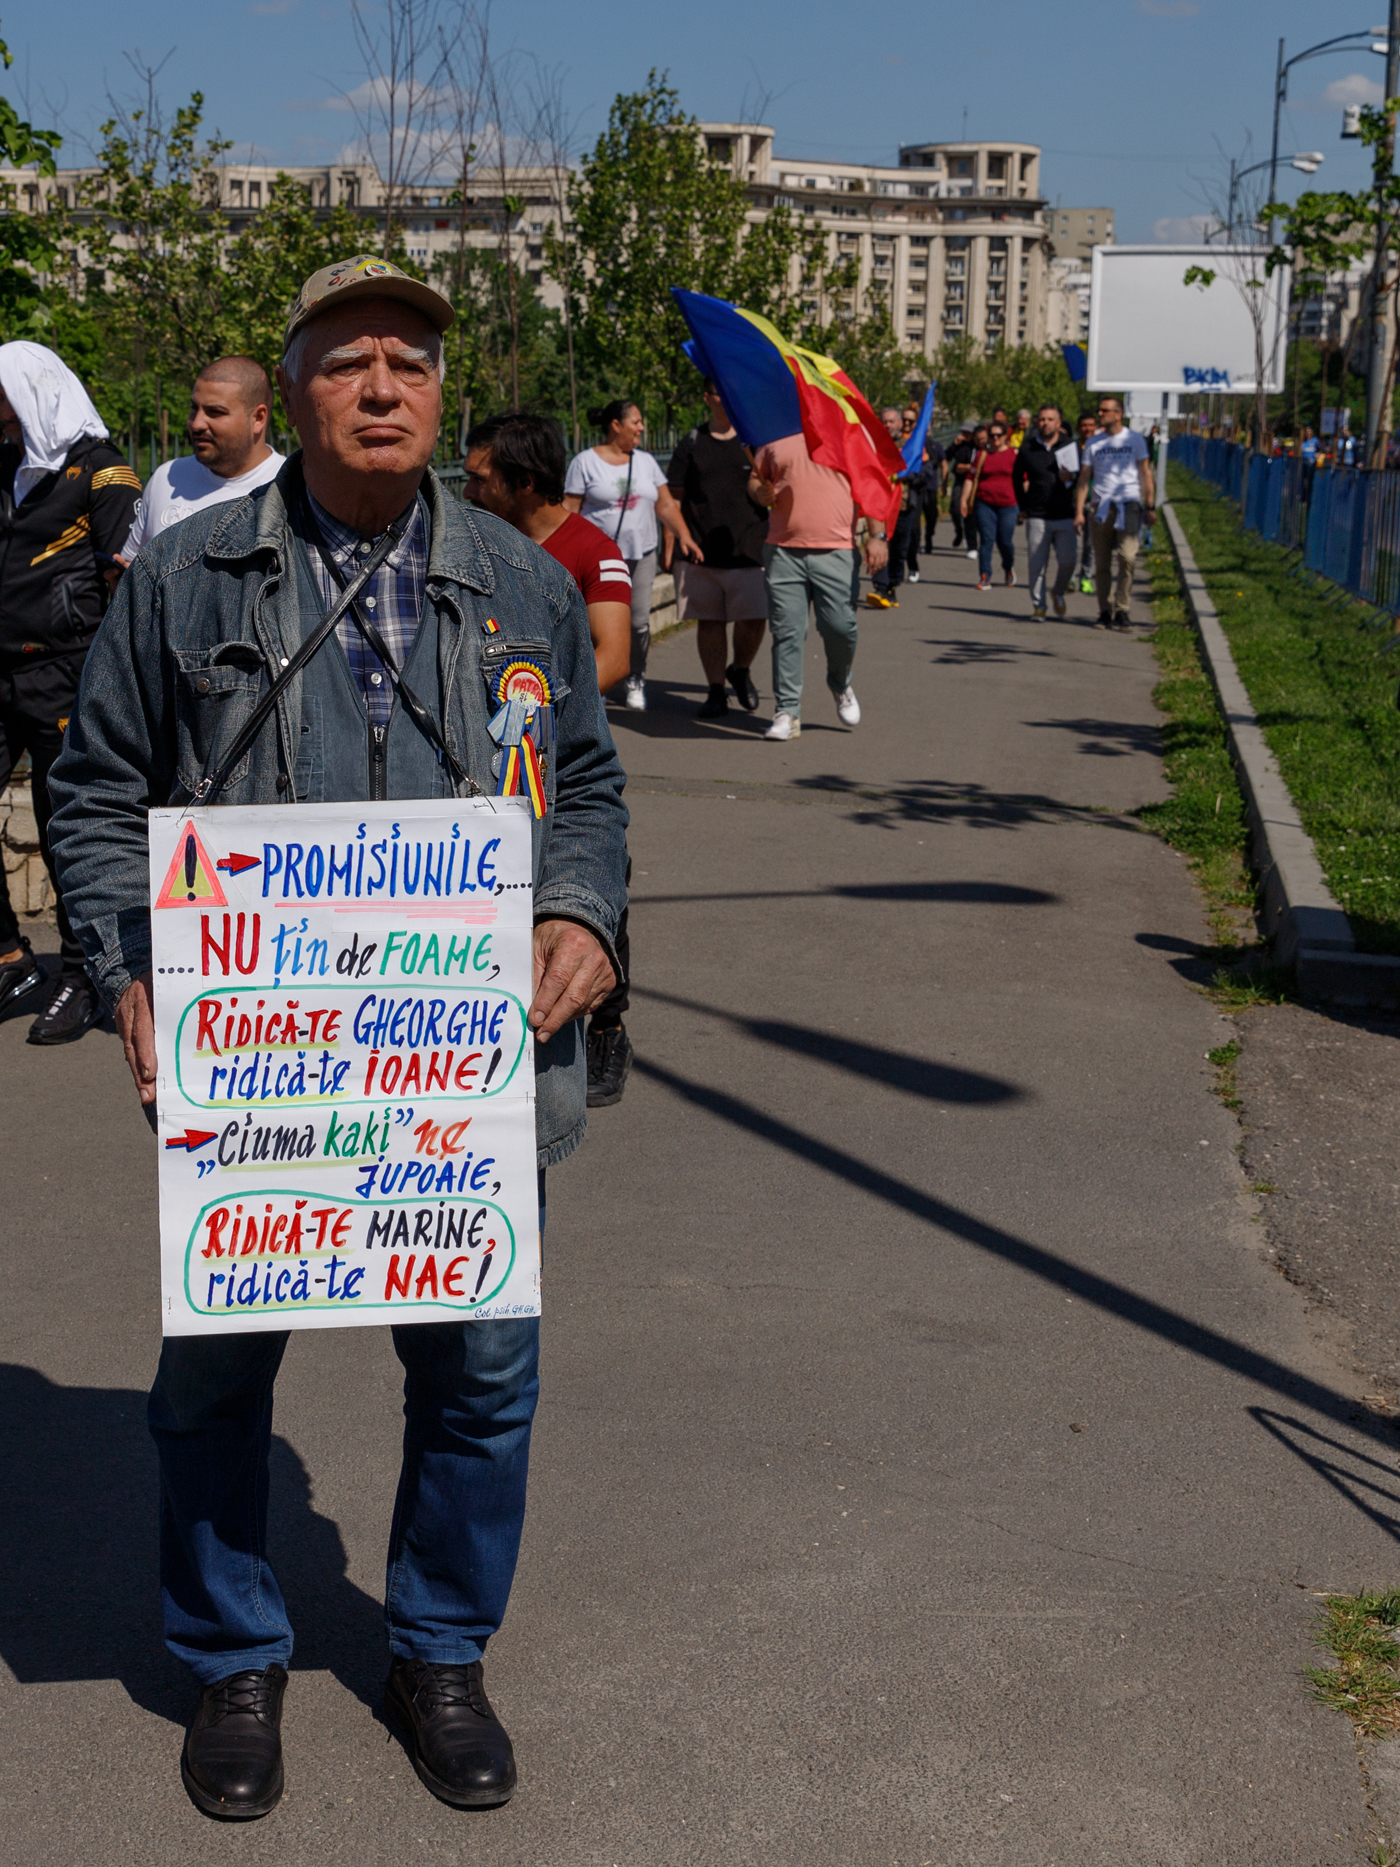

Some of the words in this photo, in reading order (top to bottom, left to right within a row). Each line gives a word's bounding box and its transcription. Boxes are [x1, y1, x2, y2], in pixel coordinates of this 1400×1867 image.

[335, 932, 378, 979] de
[378, 930, 501, 982] FOAME,
[353, 994, 509, 1050] GHEORGHE
[363, 1047, 503, 1097] IOANE!
[355, 1151, 502, 1199] JUPOAIE,
[364, 1200, 498, 1256] MARINE,
[383, 1253, 493, 1304] NAE!
